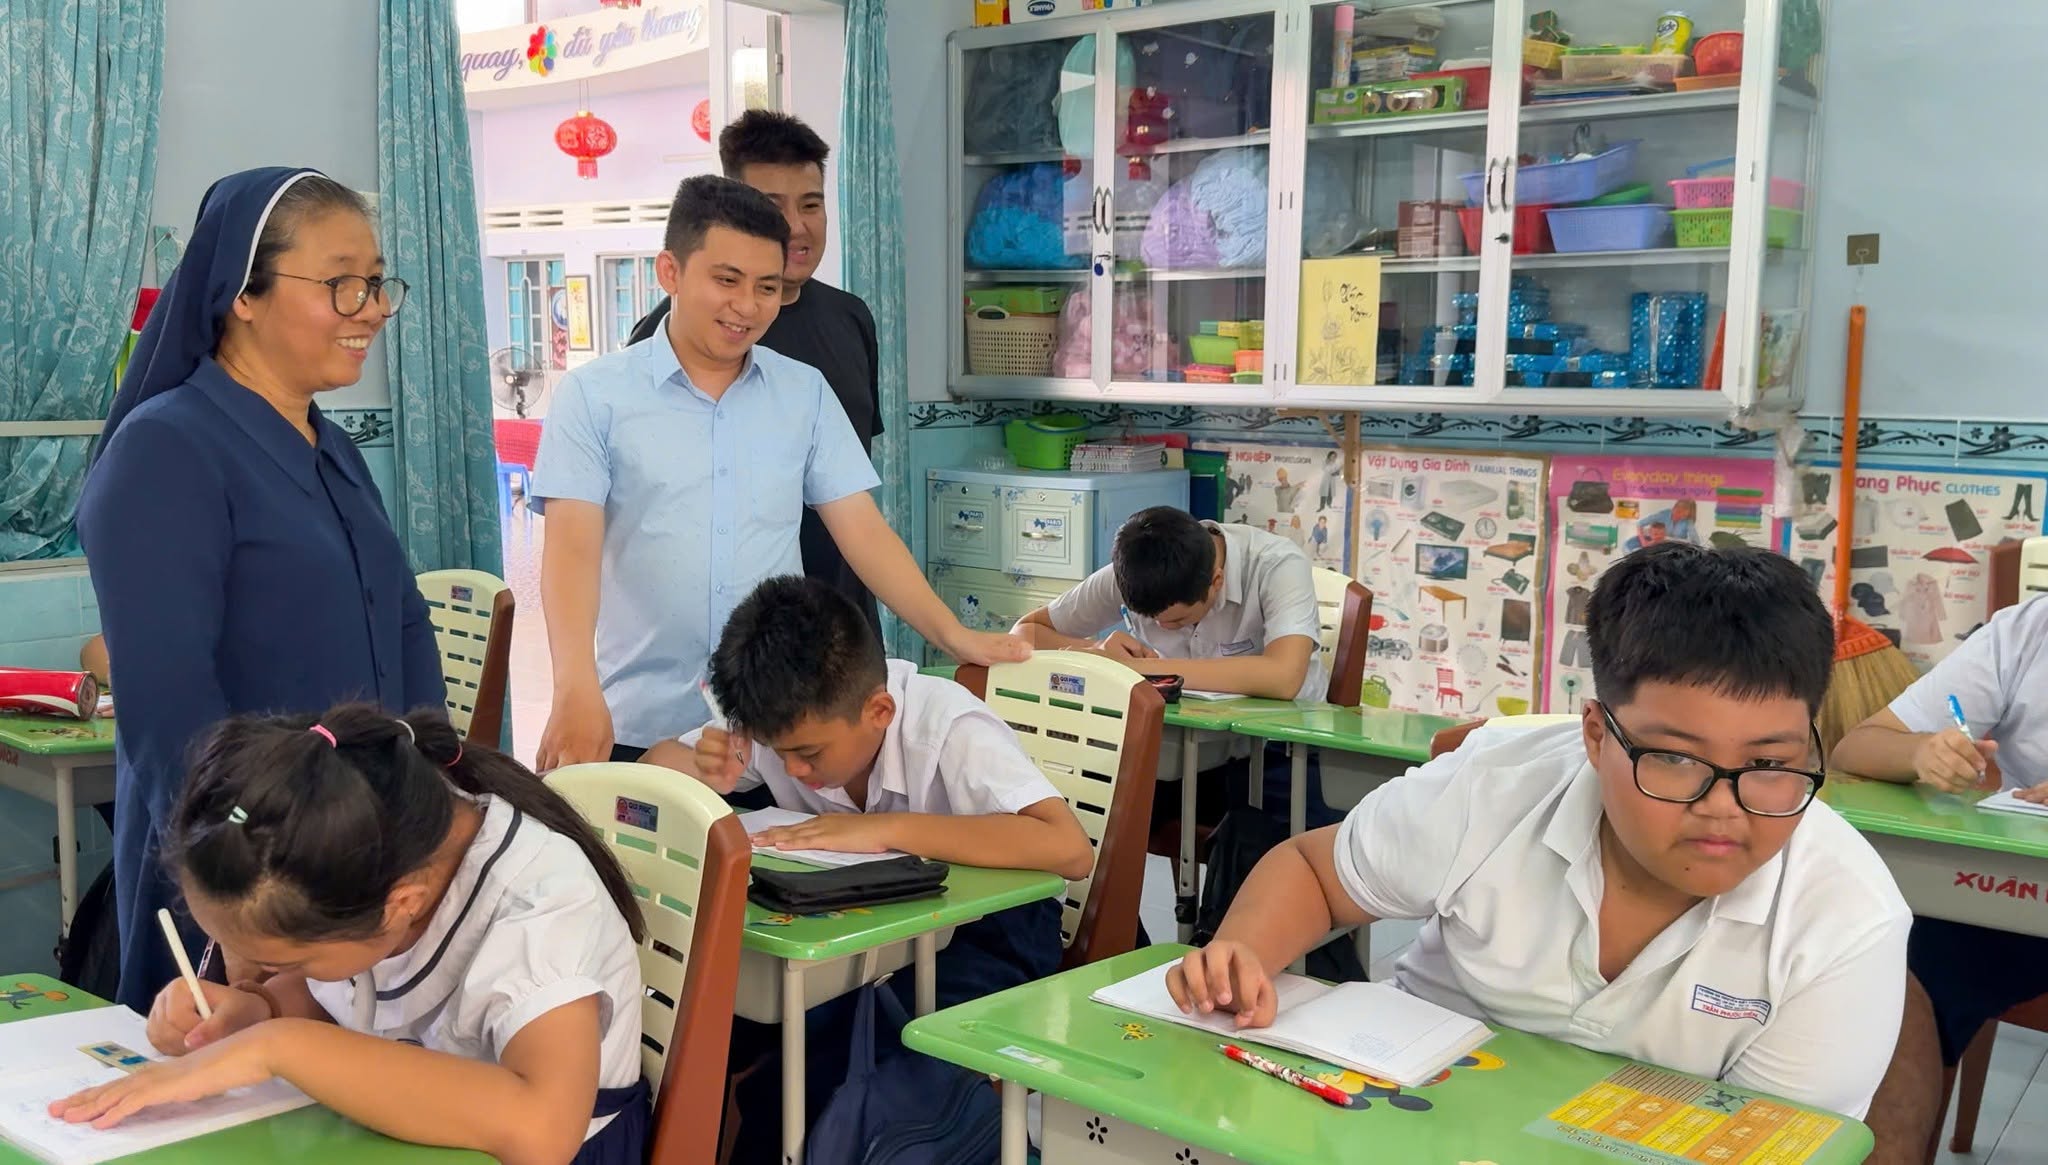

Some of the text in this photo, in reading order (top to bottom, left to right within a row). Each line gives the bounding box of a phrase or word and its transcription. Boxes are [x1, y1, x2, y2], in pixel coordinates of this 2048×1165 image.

[1367, 455, 1386, 470] Vật
[1390, 456, 1418, 472] Dụng
[1422, 457, 1441, 470] Gia
[1509, 466, 1537, 478] THINGS
[1612, 467, 1679, 485] Everyday
[1855, 475, 2001, 496] ang Phục CLOTHES
